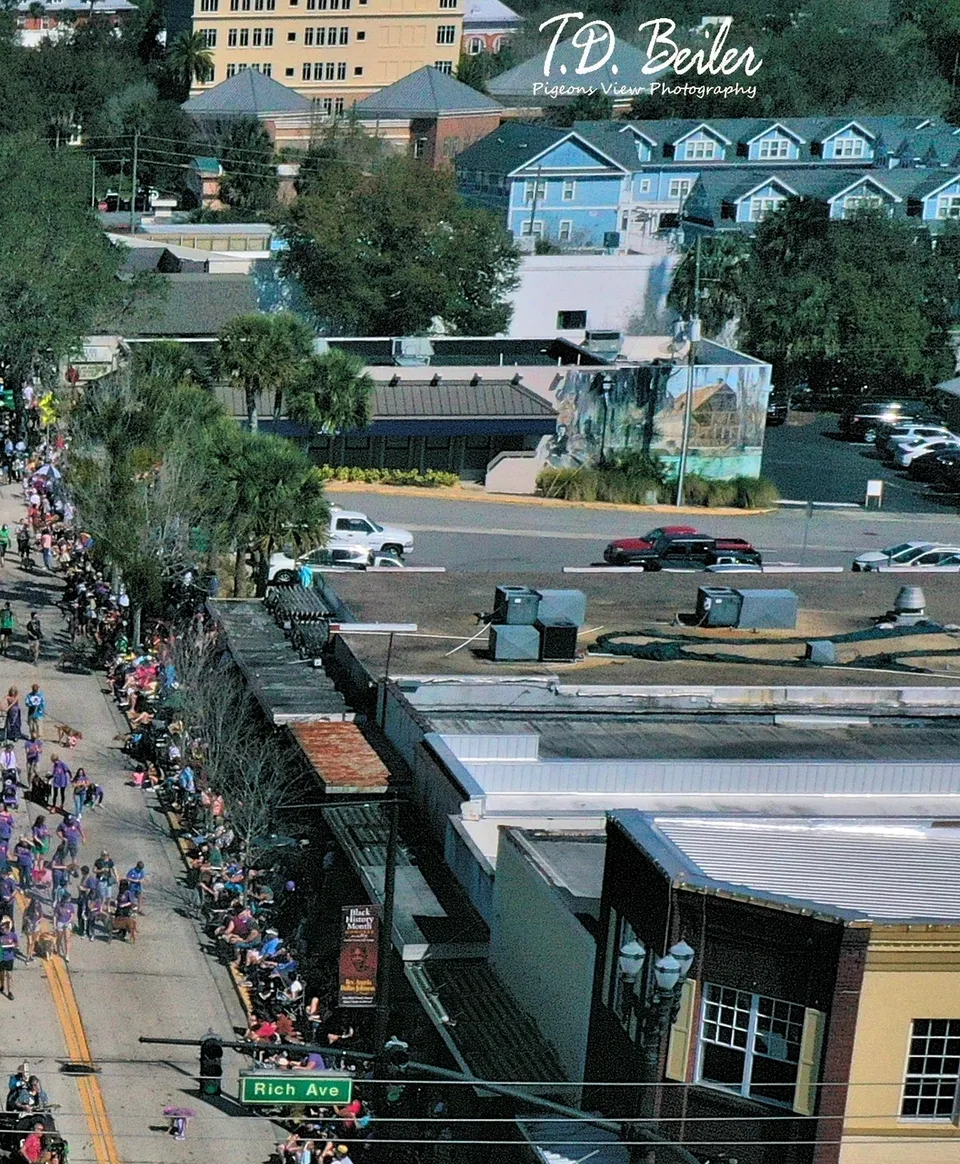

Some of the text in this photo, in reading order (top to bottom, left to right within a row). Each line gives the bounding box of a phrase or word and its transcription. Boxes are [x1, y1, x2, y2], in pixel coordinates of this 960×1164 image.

[349, 907, 371, 917] Black
[345, 915, 375, 925] History
[346, 922, 373, 931] Month
[253, 1082, 340, 1097] Rich Ave
